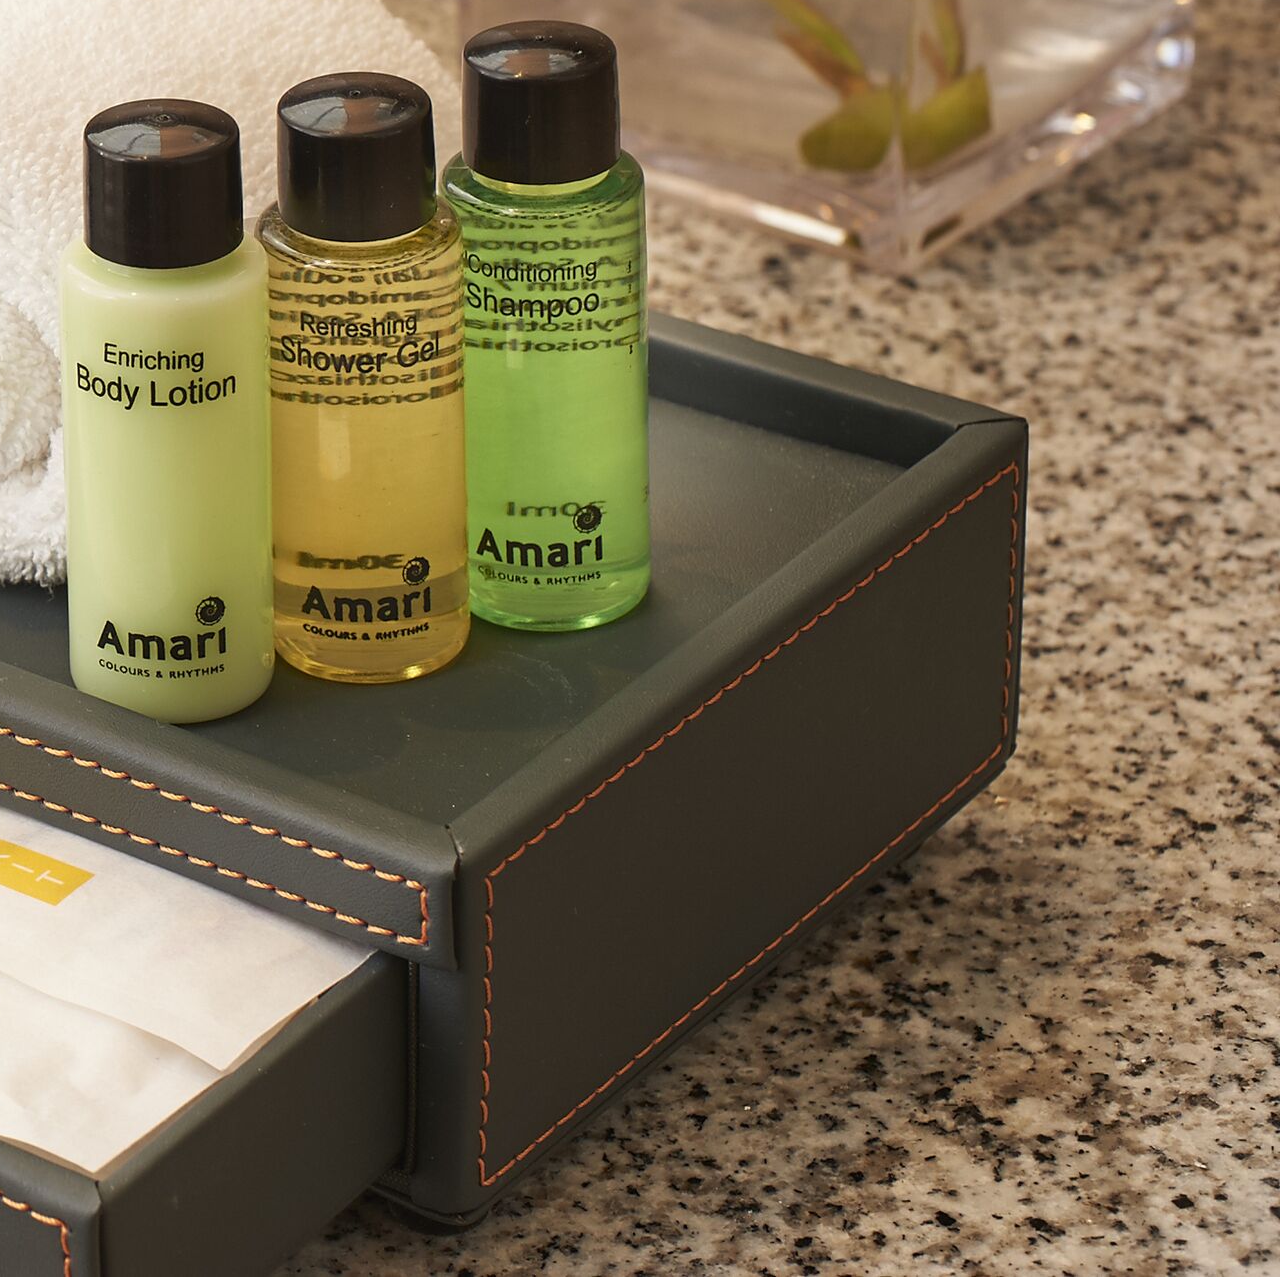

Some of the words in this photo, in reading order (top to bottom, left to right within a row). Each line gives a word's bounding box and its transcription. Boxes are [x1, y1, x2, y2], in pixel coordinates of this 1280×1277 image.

[468, 254, 598, 283] Conditioning
[466, 282, 600, 324] Shampoo
[300, 312, 417, 338] Refreshing
[104, 342, 204, 373] Enriching
[280, 335, 387, 374] Shower
[396, 331, 440, 368] Gel
[77, 362, 140, 410] Body
[150, 375, 236, 407] Lotion
[476, 505, 603, 568] Amari
[302, 556, 431, 623] Amari
[478, 565, 528, 584] COLOURS
[533, 577, 541, 585] &
[546, 571, 601, 585] RHYTHMS
[97, 596, 226, 661] Amari
[303, 623, 357, 640] COLOURS
[361, 632, 370, 641] &
[375, 622, 429, 640] RHYTHMS
[98, 658, 150, 678] COLOURS
[155, 670, 163, 679] &
[169, 663, 225, 679] RHYTHMS
